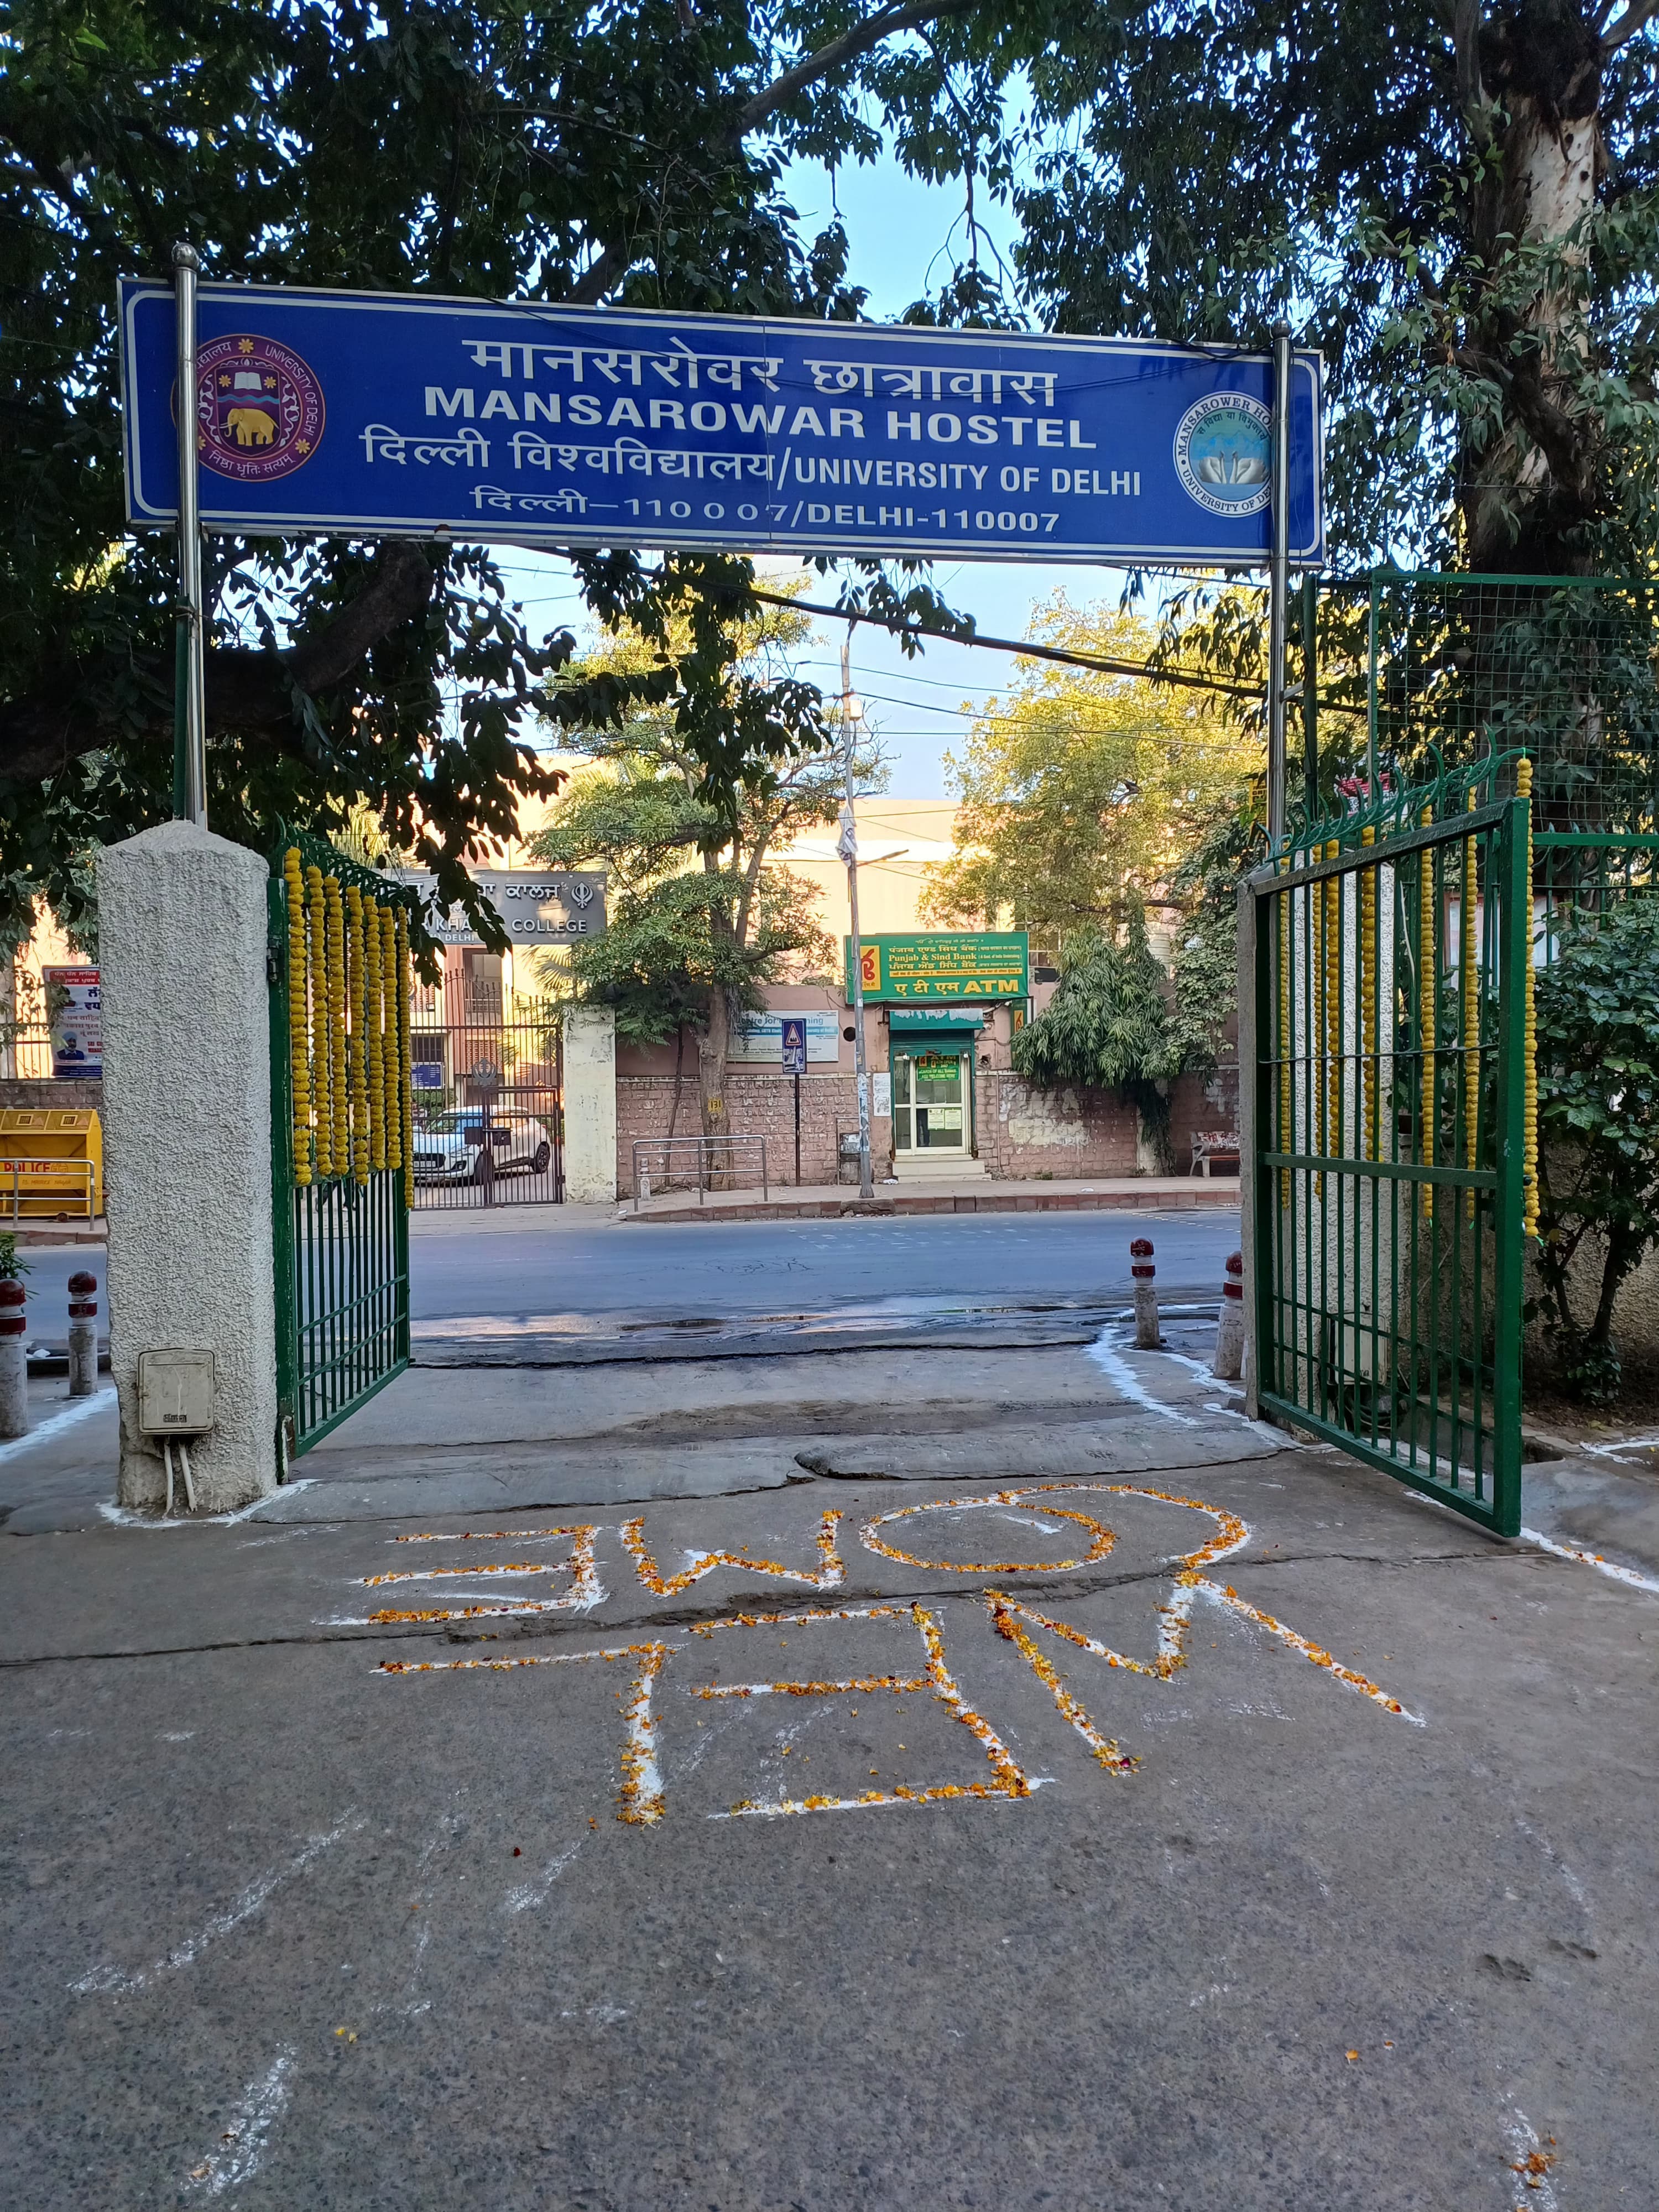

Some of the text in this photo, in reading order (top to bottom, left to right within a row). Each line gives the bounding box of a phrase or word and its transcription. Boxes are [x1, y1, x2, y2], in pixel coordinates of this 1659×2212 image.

[462, 336, 1058, 406] मानसरोवर छात्रावास
[265, 345, 317, 436] UNIVERSITY OF DELHI
[425, 387, 1097, 448] MANSAROWAR HOSTEL
[1178, 397, 1251, 456] MANSAROWER
[1226, 411, 1235, 420] या
[208, 450, 234, 470] निष्ठा
[264, 452, 296, 473] सत्यम्
[359, 424, 491, 467] दिल्ली
[1000, 466, 1040, 492] OF
[1052, 468, 1141, 496] DELHI
[1183, 468, 1239, 512] UNIVERSITY
[1241, 499, 1255, 510] OF
[505, 883, 562, 899] ਕਾਲਜ
[511, 919, 587, 933] COLLEGE
[889, 954, 919, 962] Punjab
[894, 979, 1018, 995] ए टी एम ATM
[4, 1162, 51, 1173] POLICE
